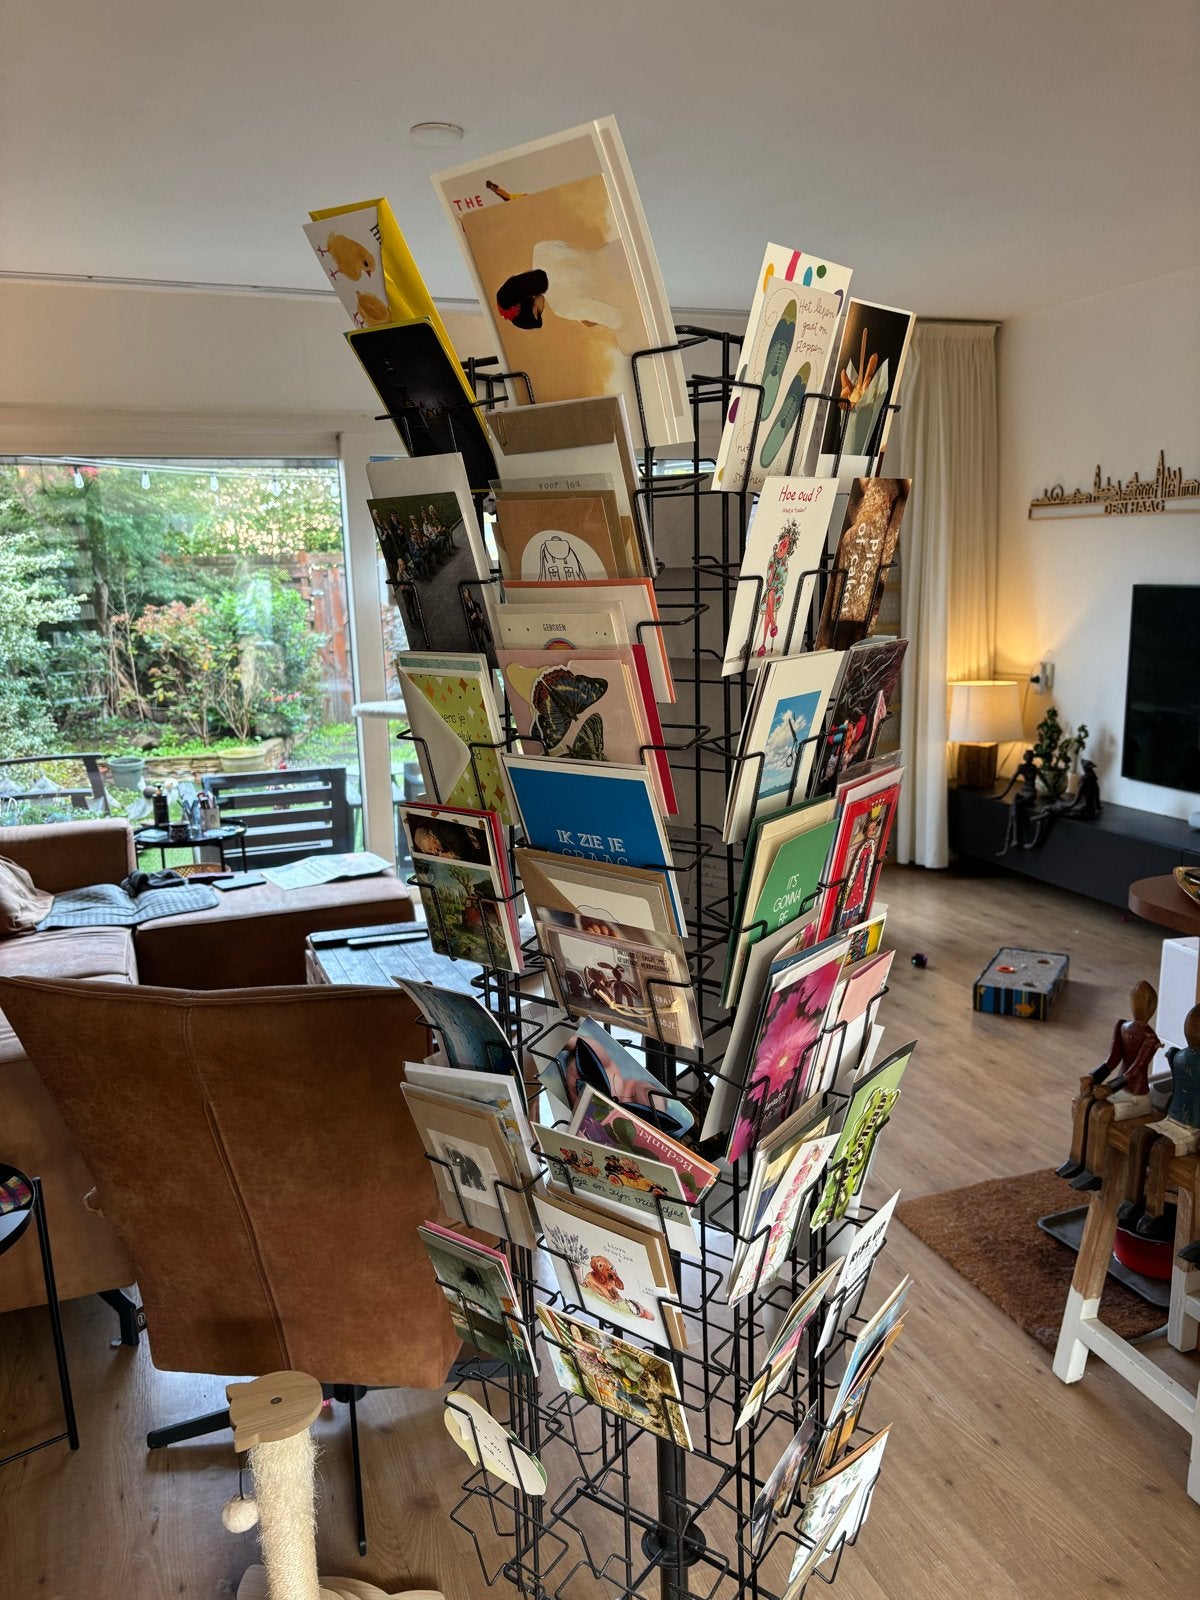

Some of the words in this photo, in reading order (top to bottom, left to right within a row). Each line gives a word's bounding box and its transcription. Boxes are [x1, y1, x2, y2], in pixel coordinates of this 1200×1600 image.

[453, 195, 484, 212] THE
[538, 481, 559, 490] voor
[565, 479, 581, 490] jou
[778, 485, 796, 502] Hoe
[1104, 502, 1128, 515] DEN
[1130, 500, 1166, 514] HAAG
[855, 522, 867, 546] of
[556, 829, 576, 845] IK
[577, 832, 605, 850] ZIE
[607, 836, 626, 853] JE
[773, 887, 802, 912] GONNA
[638, 1128, 694, 1172] Bedankt
[593, 1183, 606, 1193] en
[609, 1187, 630, 1202] zijn
[849, 1234, 873, 1266] RISE
[873, 1220, 887, 1241] UP
